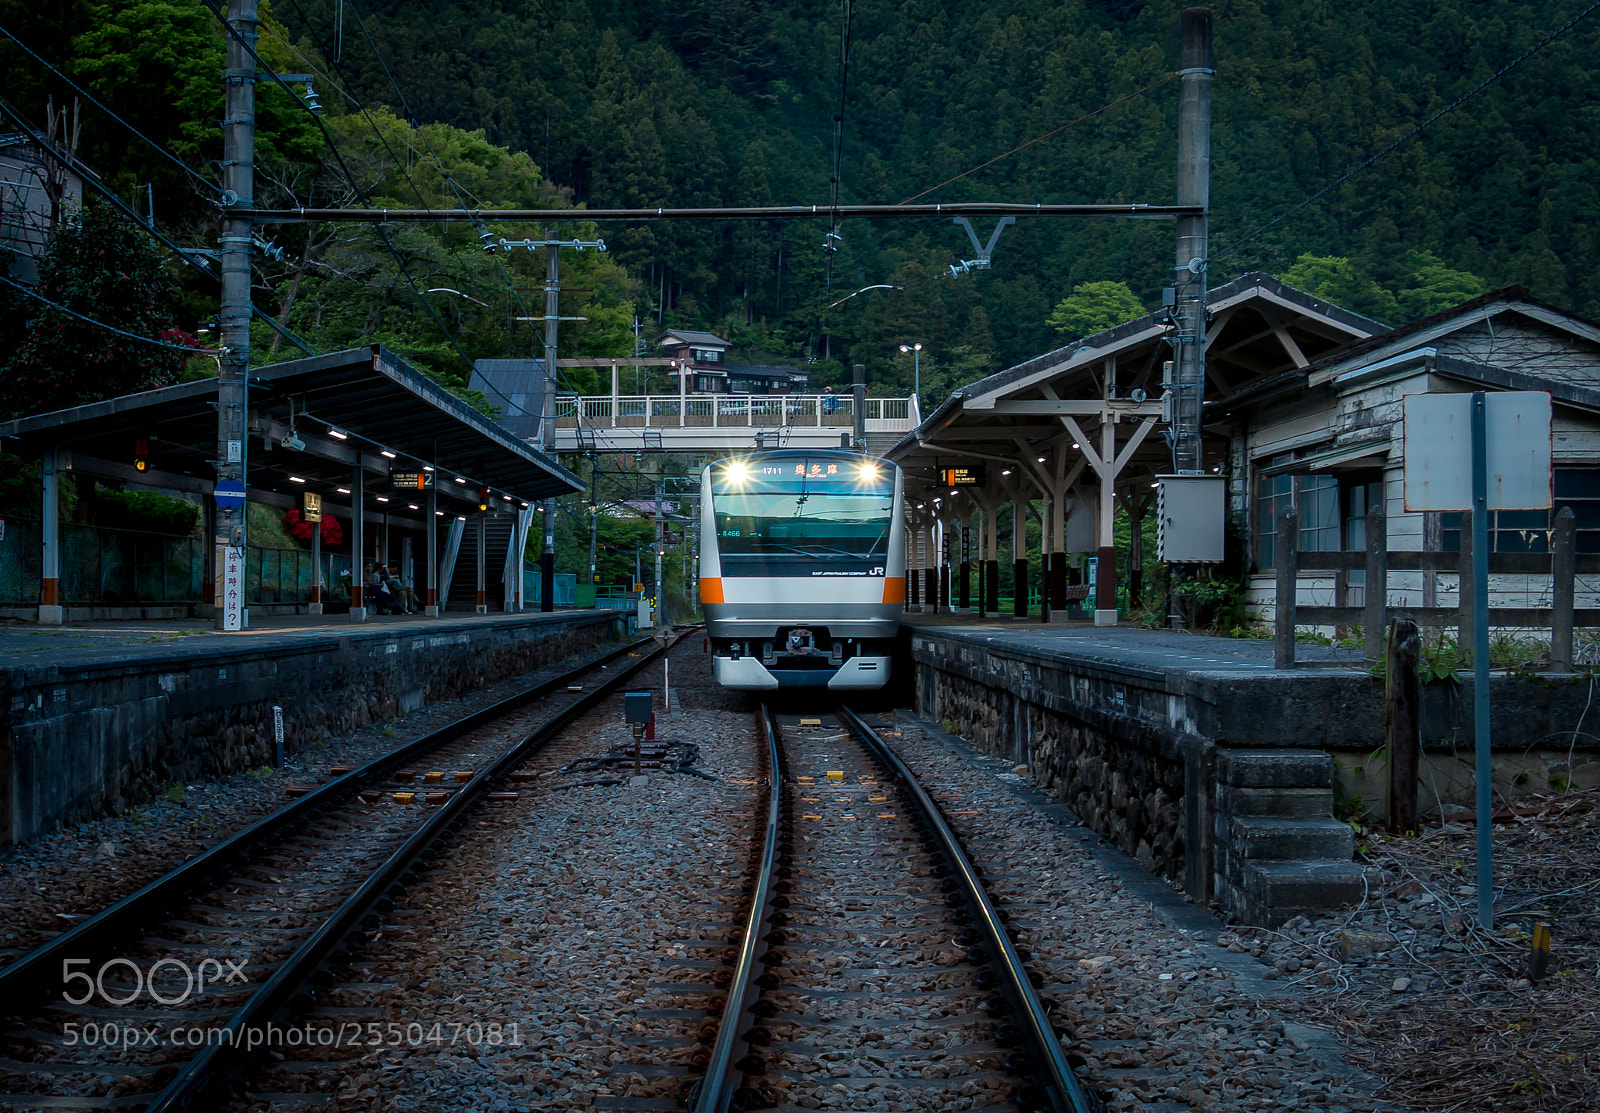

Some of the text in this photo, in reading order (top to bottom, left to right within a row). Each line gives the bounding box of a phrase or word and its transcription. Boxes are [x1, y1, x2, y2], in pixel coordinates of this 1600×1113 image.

[763, 467, 782, 475] 1711
[794, 464, 838, 475] 奥多摩
[424, 473, 432, 485] 2
[940, 469, 946, 482] 1
[868, 566, 884, 576] JR
